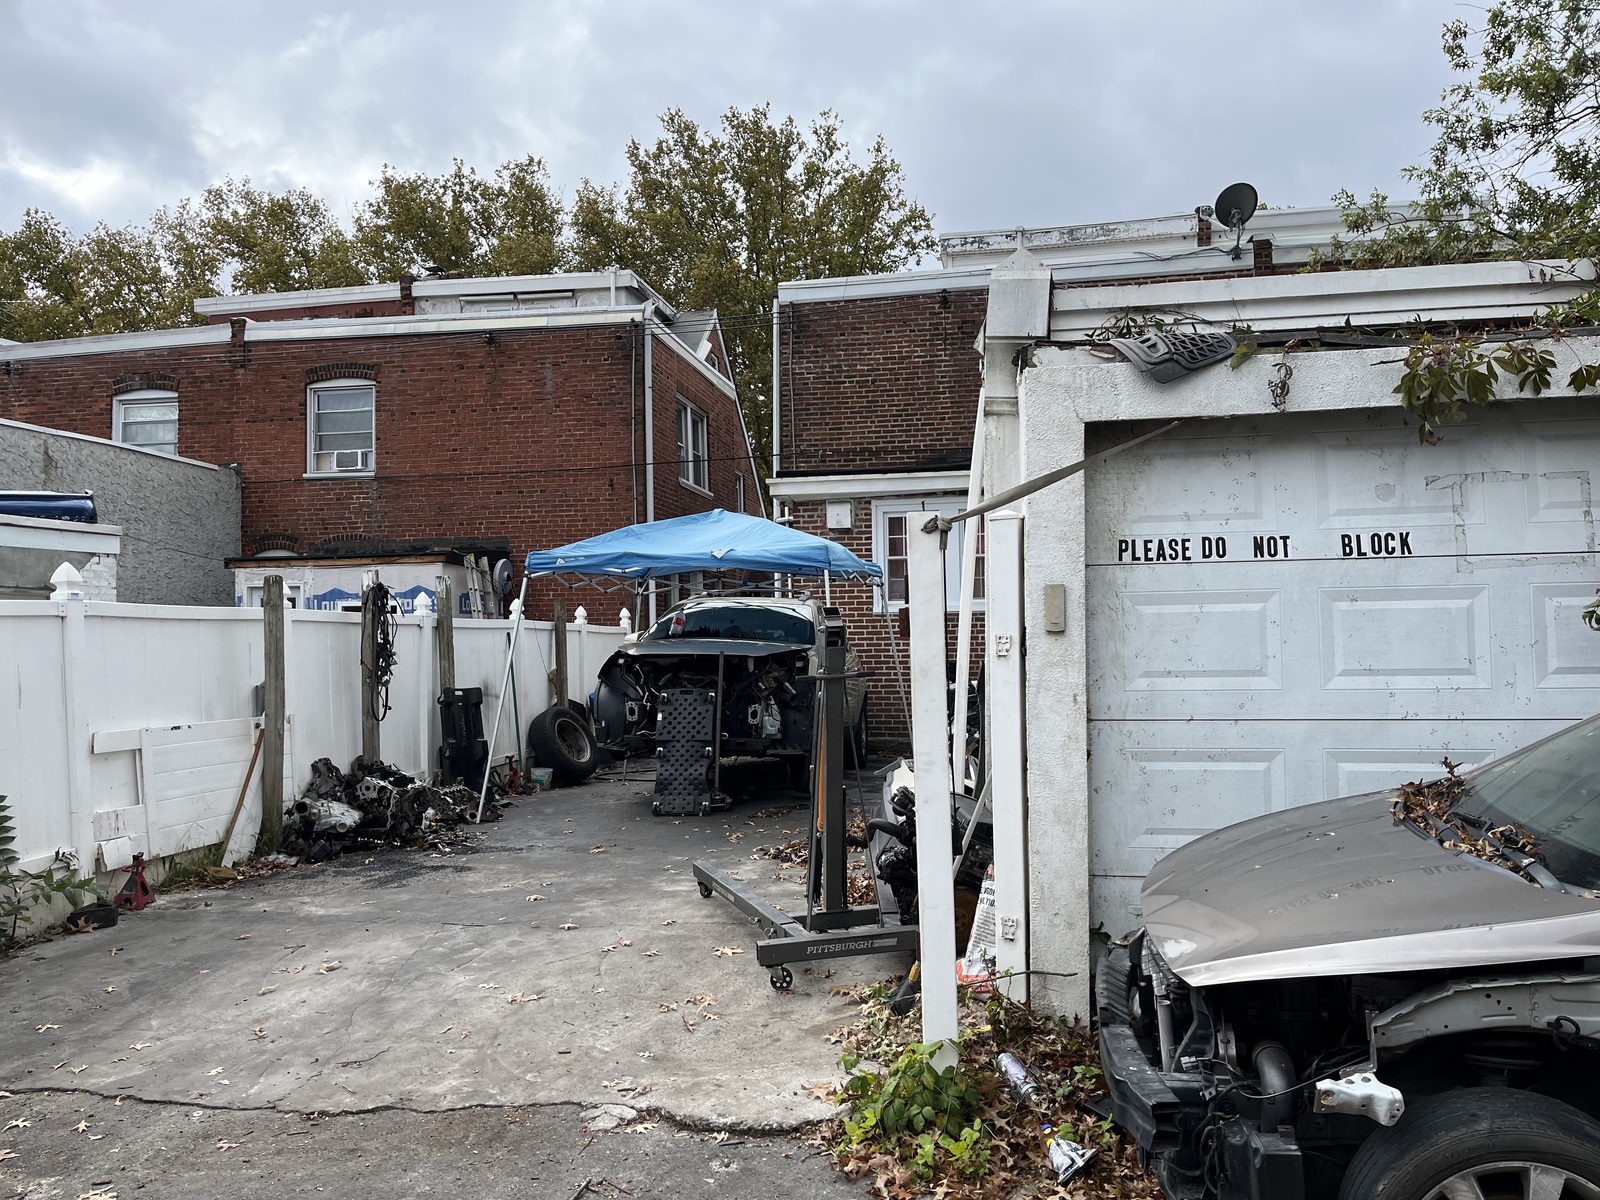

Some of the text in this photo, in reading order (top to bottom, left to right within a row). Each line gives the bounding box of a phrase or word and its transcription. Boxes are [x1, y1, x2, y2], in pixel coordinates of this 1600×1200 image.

[1118, 532, 1412, 562] PLEASE DO NOT BLOCK
[806, 940, 873, 955] PITTSBURGH
